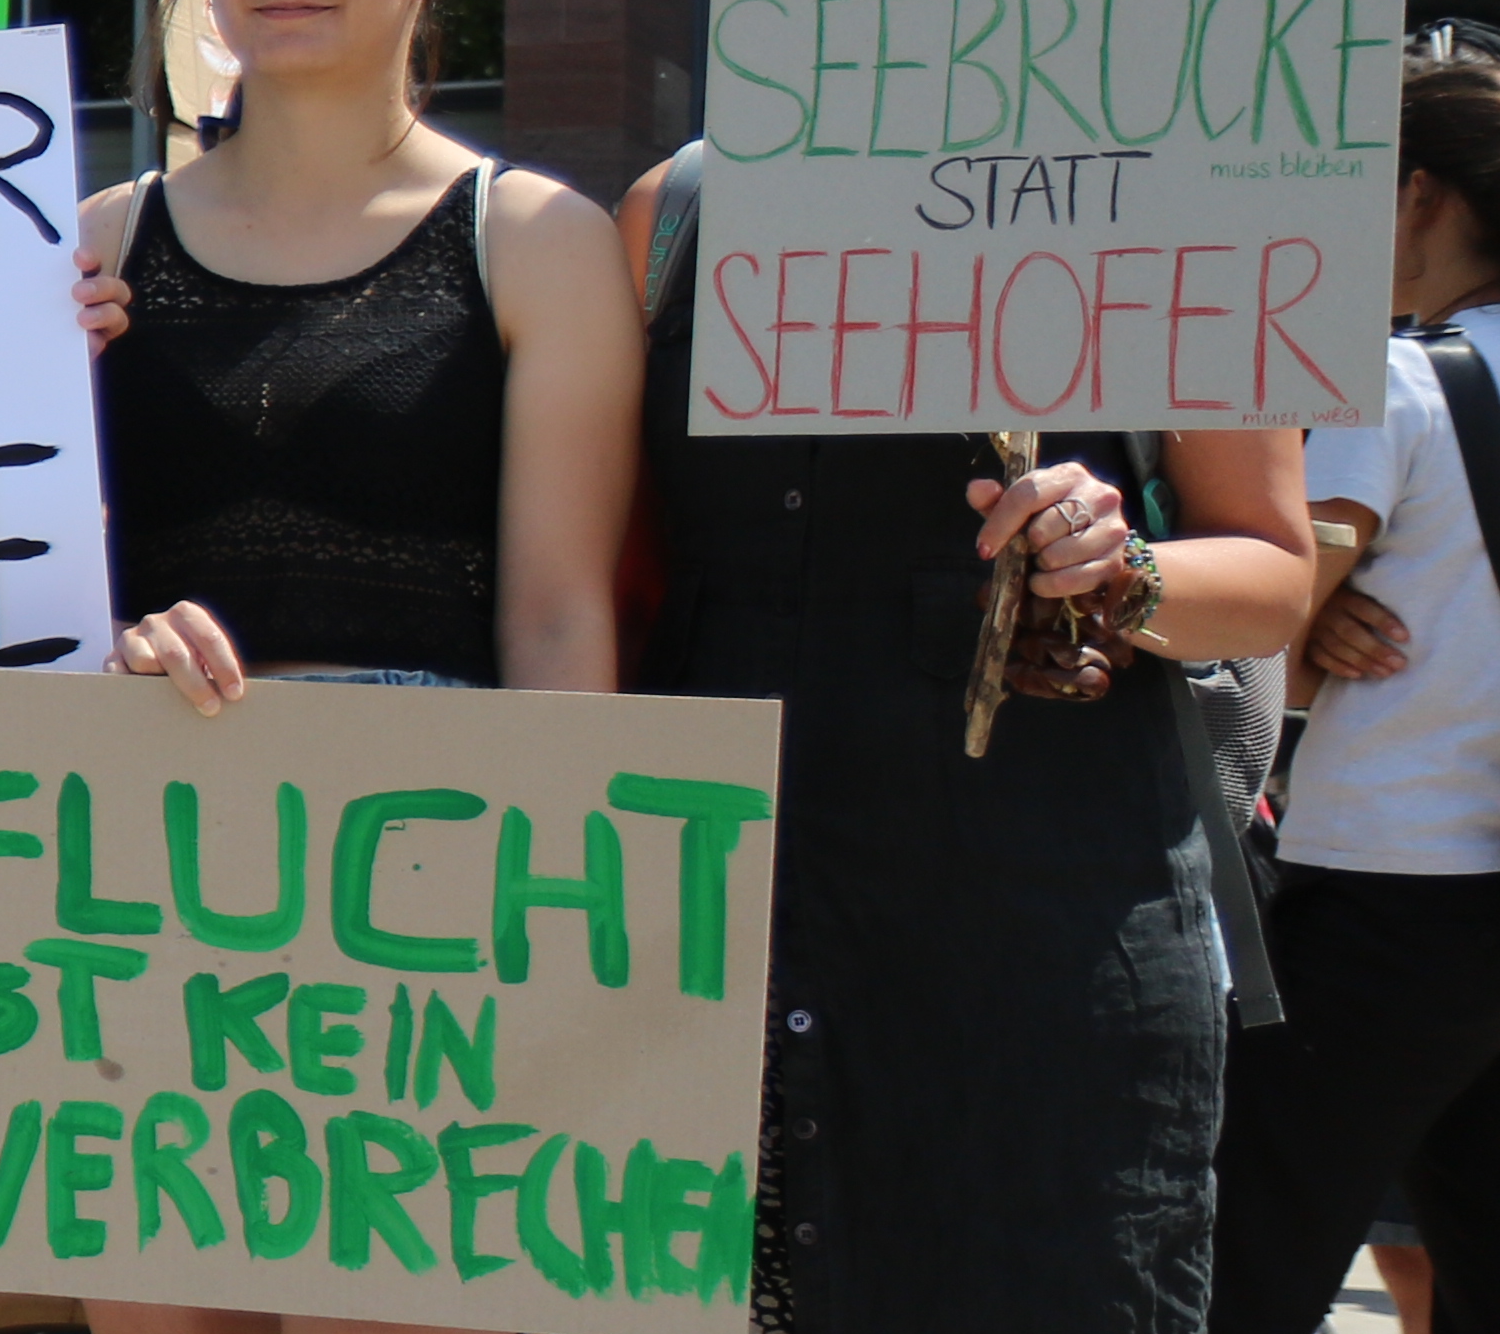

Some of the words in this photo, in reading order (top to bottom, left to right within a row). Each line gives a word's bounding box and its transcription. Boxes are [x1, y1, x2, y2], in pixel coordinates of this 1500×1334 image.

[915, 150, 1151, 229] STATT
[1210, 161, 1271, 179] muss
[1280, 151, 1363, 178] bleiben
[704, 237, 1346, 422] SEEHOFER
[1242, 411, 1298, 425] muss
[1312, 407, 1360, 427] weg
[183, 972, 497, 1112] KEIN
